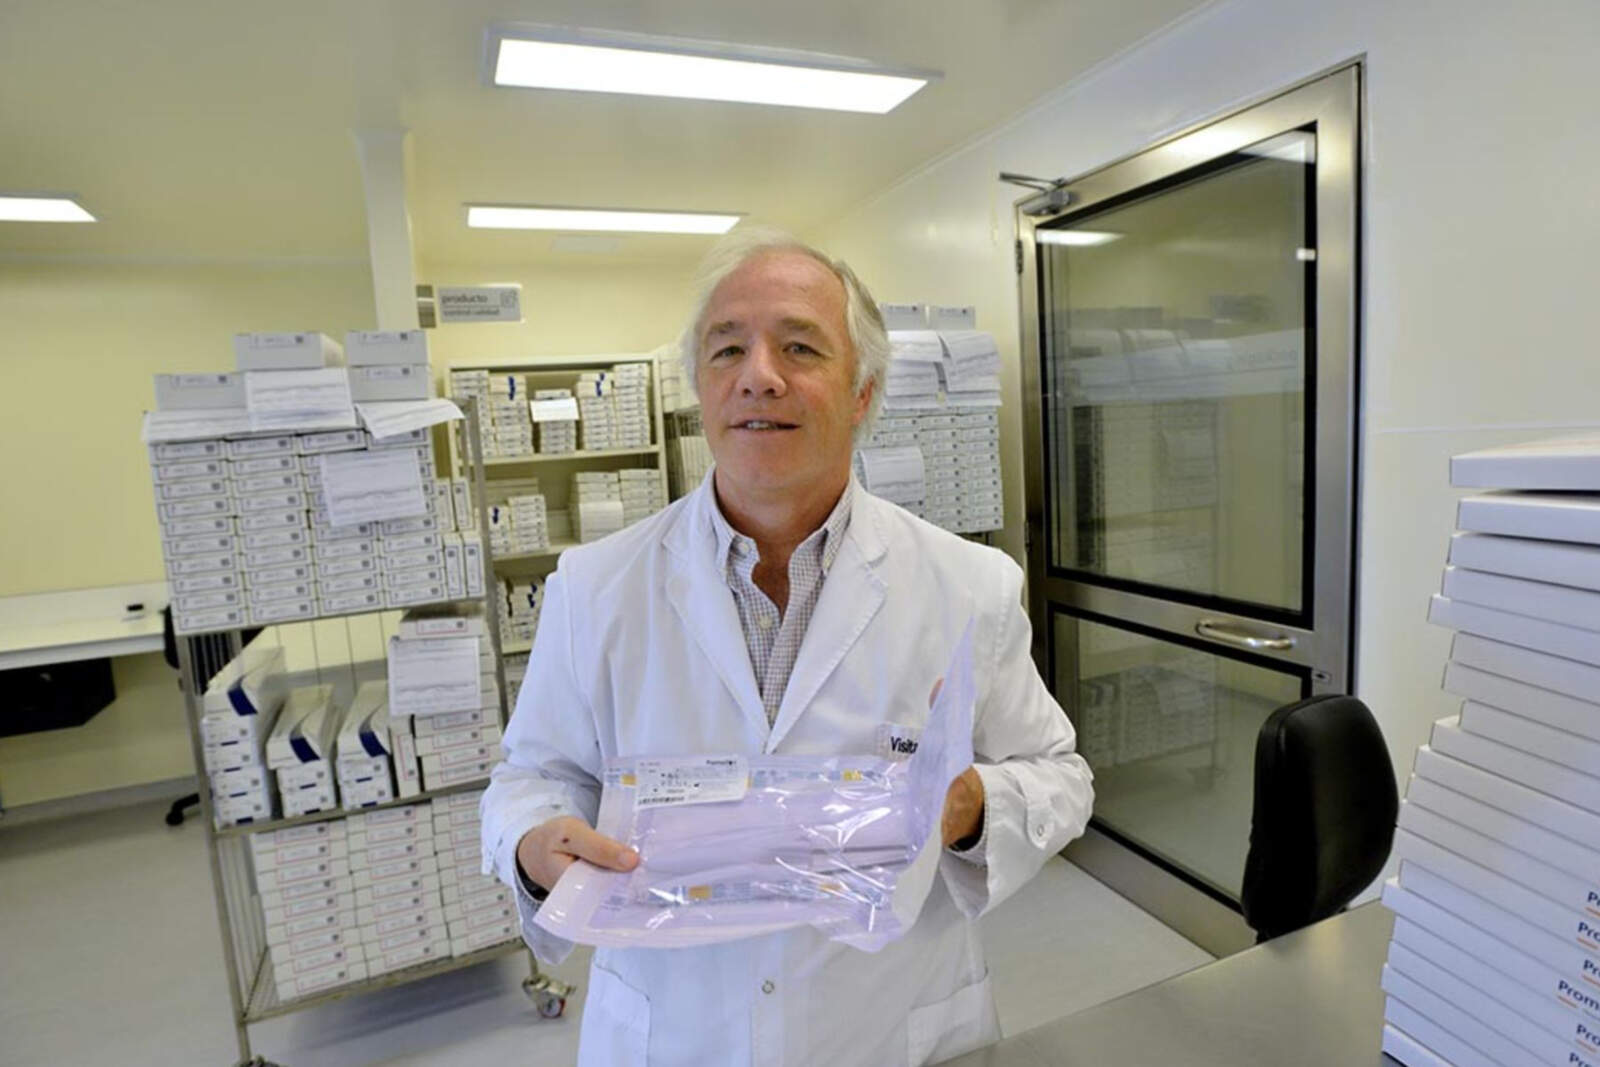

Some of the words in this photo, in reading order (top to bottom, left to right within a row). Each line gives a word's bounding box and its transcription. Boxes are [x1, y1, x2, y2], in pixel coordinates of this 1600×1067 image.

[1583, 959, 1600, 979] Pr
[1558, 980, 1600, 1011] Prom
[1569, 1052, 1592, 1067] Pr
